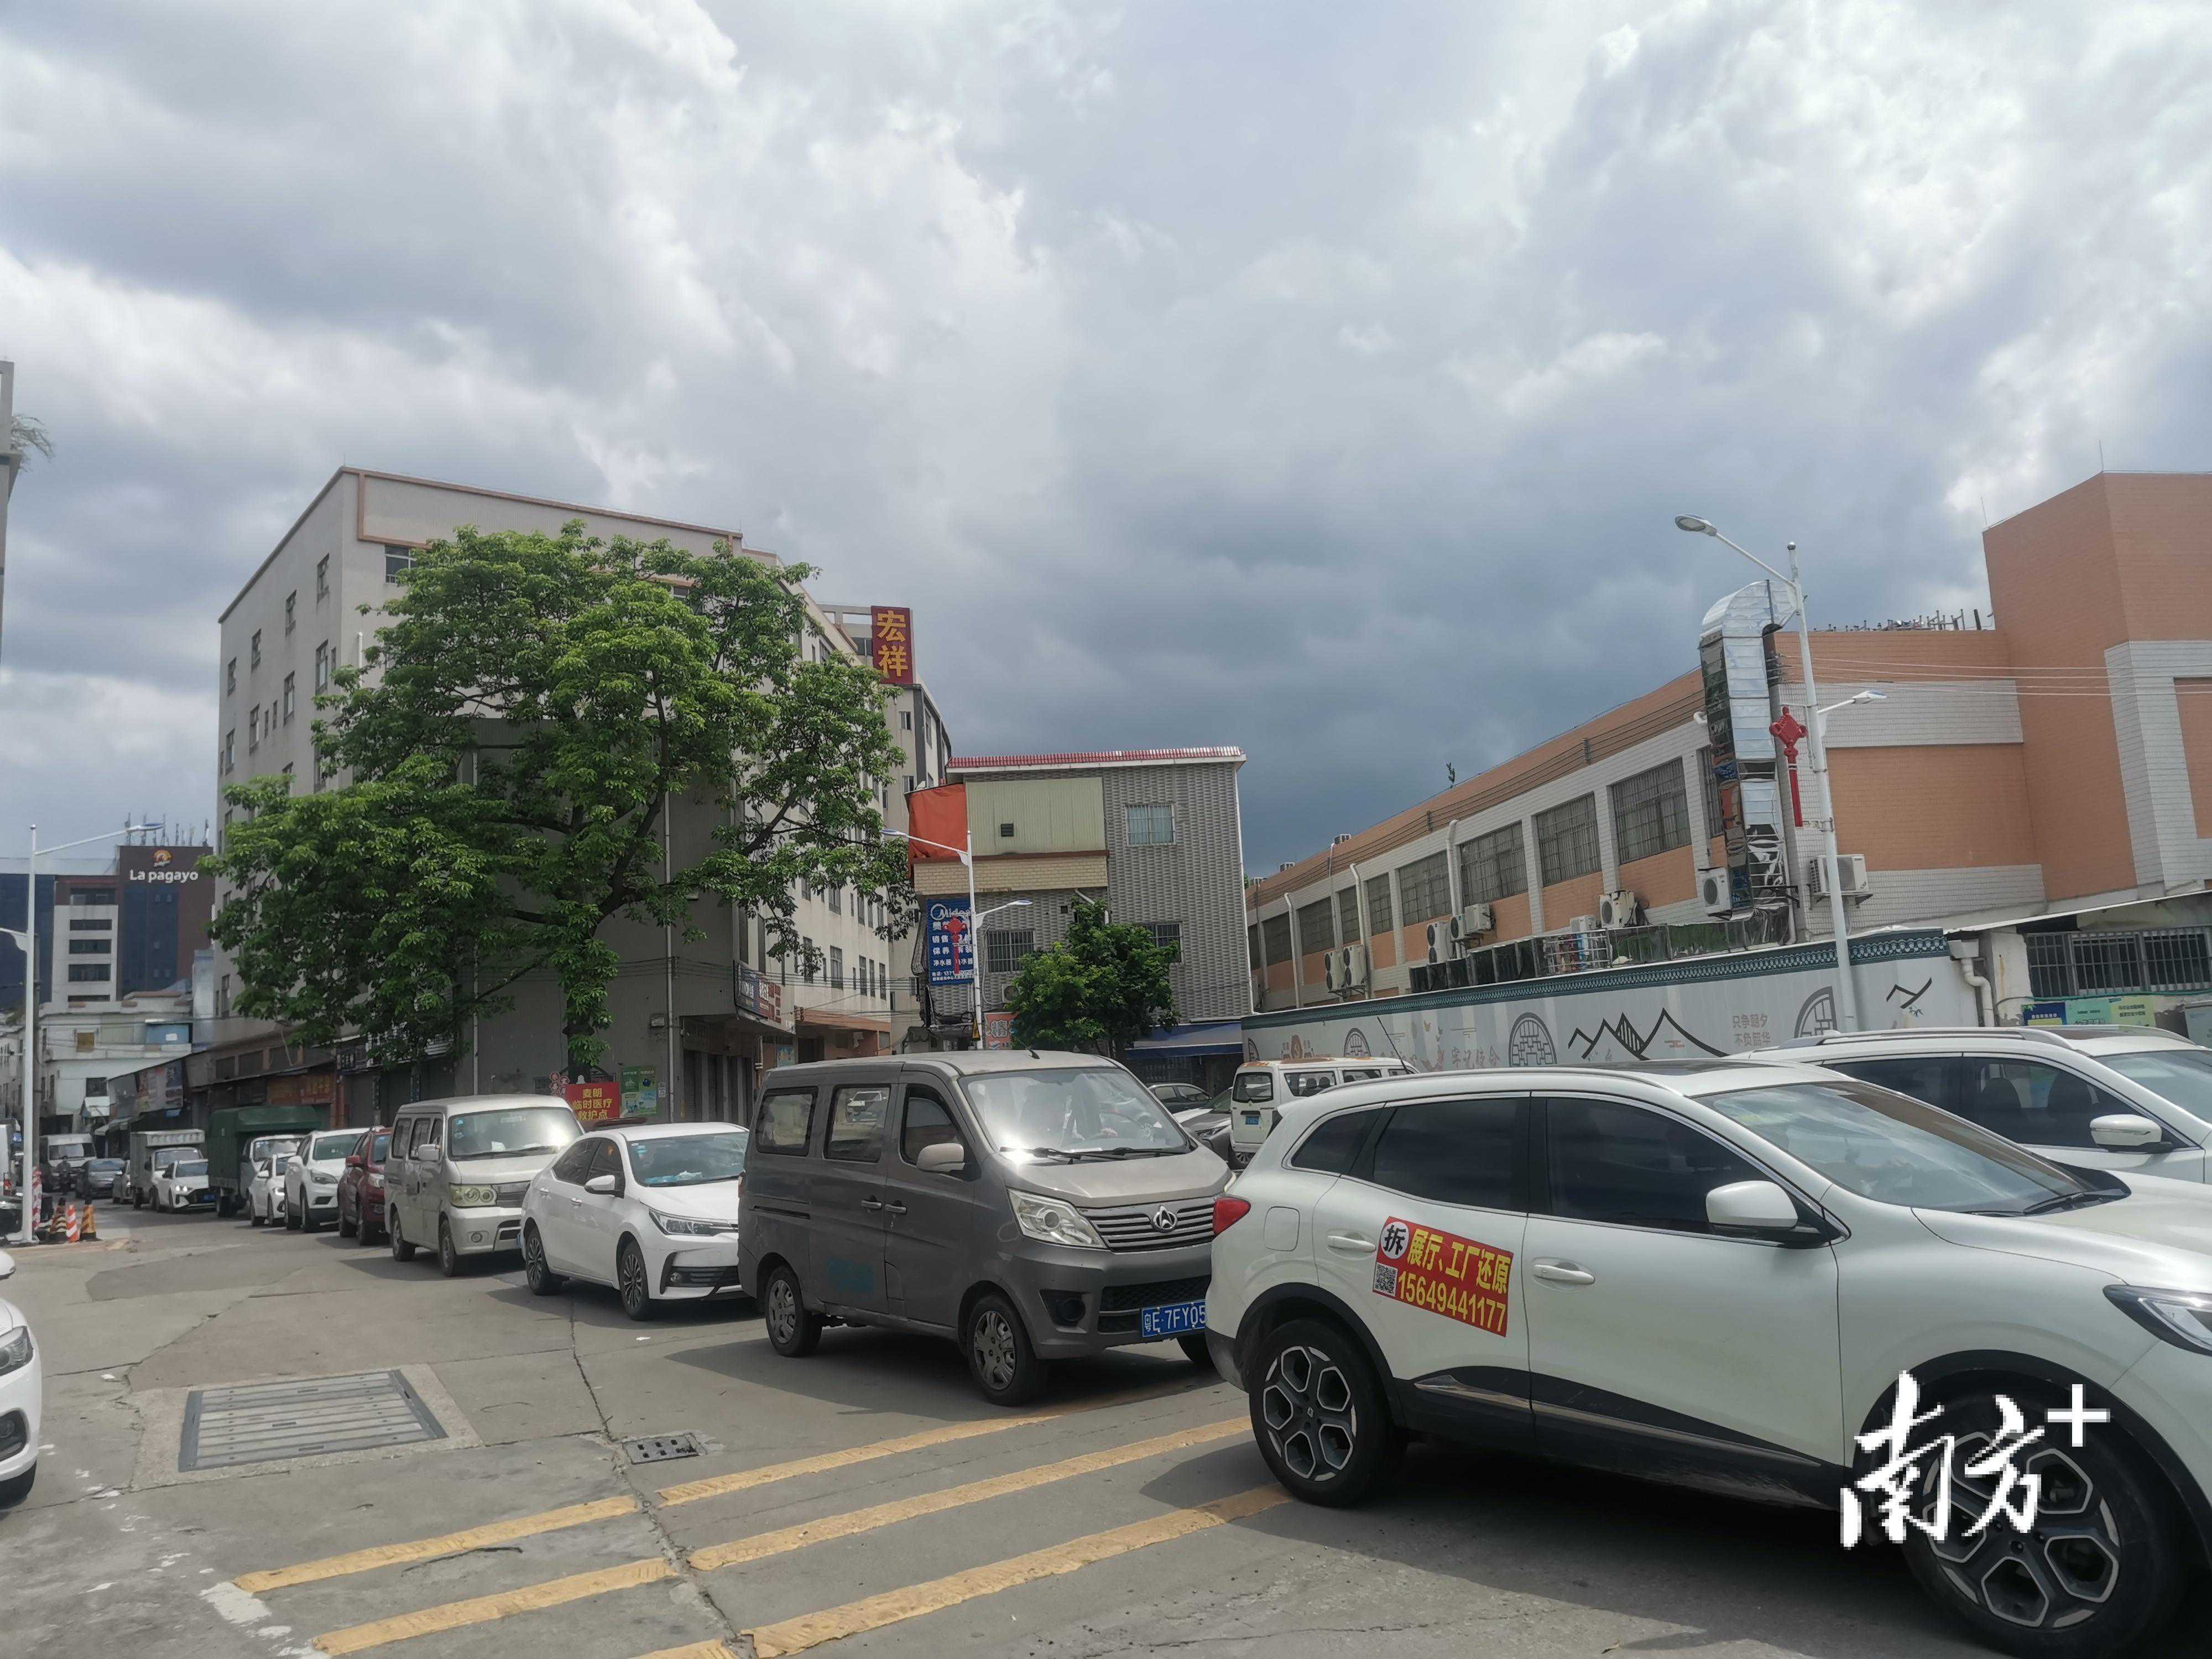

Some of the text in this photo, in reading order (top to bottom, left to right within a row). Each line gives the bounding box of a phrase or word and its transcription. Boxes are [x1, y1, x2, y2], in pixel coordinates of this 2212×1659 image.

[877, 610, 908, 677] 宏祥
[130, 869, 199, 883] La pagayo
[572, 1098, 613, 1109] 临时医疗
[1383, 1224, 1406, 1255] 拆
[1407, 1228, 1511, 1294] 展厅、工厂还原
[1398, 1271, 1506, 1332] 15649441177
